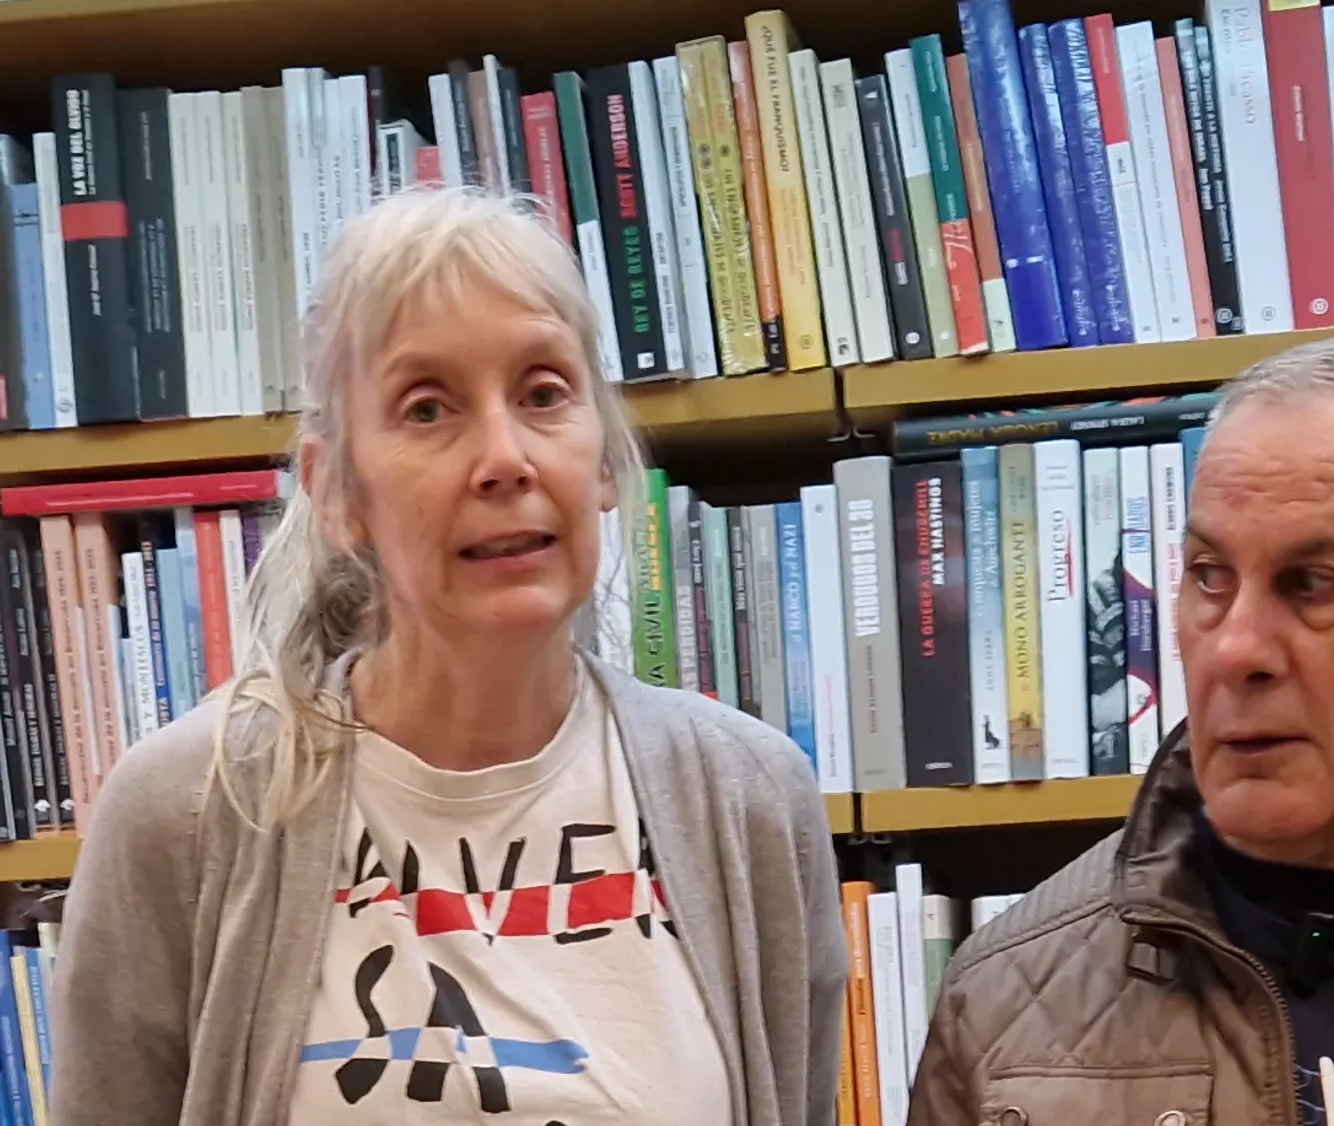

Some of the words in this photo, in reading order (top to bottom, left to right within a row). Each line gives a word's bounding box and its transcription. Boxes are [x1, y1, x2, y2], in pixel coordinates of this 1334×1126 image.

[782, 523, 798, 559] NAZI
[848, 523, 877, 552] DEL
[927, 477, 945, 549] HASTINGS
[930, 551, 945, 586] MAX
[1011, 520, 1029, 622] ARROGANTE
[1046, 509, 1071, 604] Progreso
[850, 554, 882, 637] VERDUGOS
[1014, 626, 1031, 679] MONO
[334, 943, 512, 1114] SA
